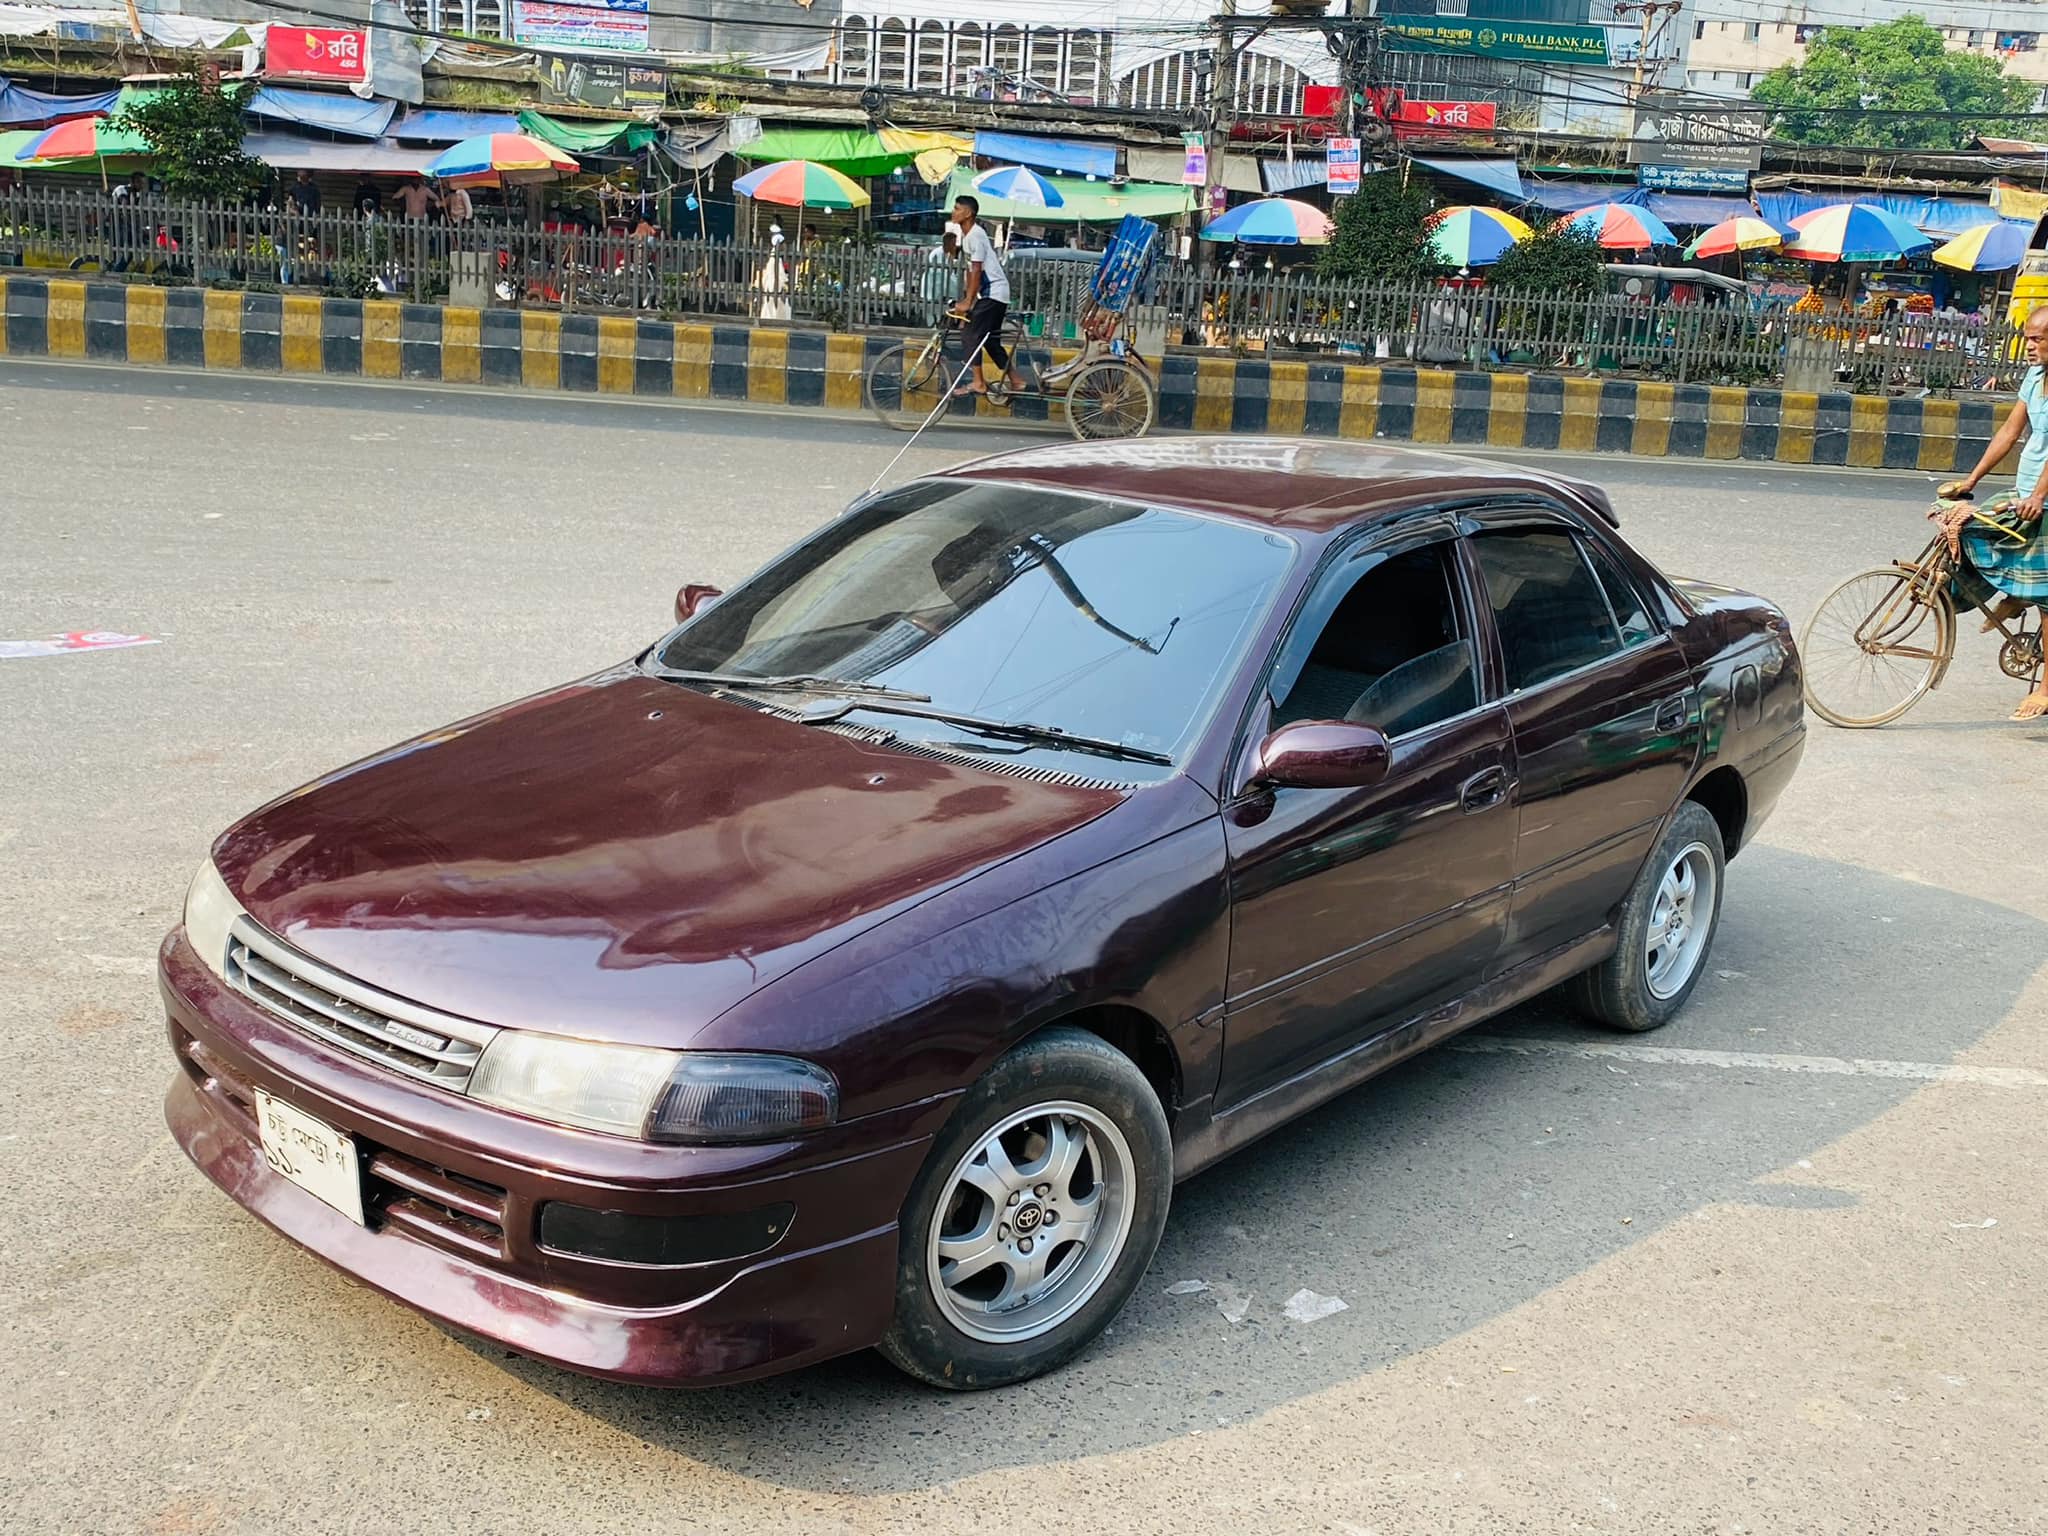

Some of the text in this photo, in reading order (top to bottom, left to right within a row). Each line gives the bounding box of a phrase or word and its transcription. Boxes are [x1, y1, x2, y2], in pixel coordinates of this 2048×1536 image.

[327, 34, 359, 59] রবি
[1501, 32, 1605, 49] PUBALI BANK PLC
[1442, 104, 1469, 124] রবি
[1659, 112, 1683, 139] হাজী
[1333, 139, 1353, 150] HSC
